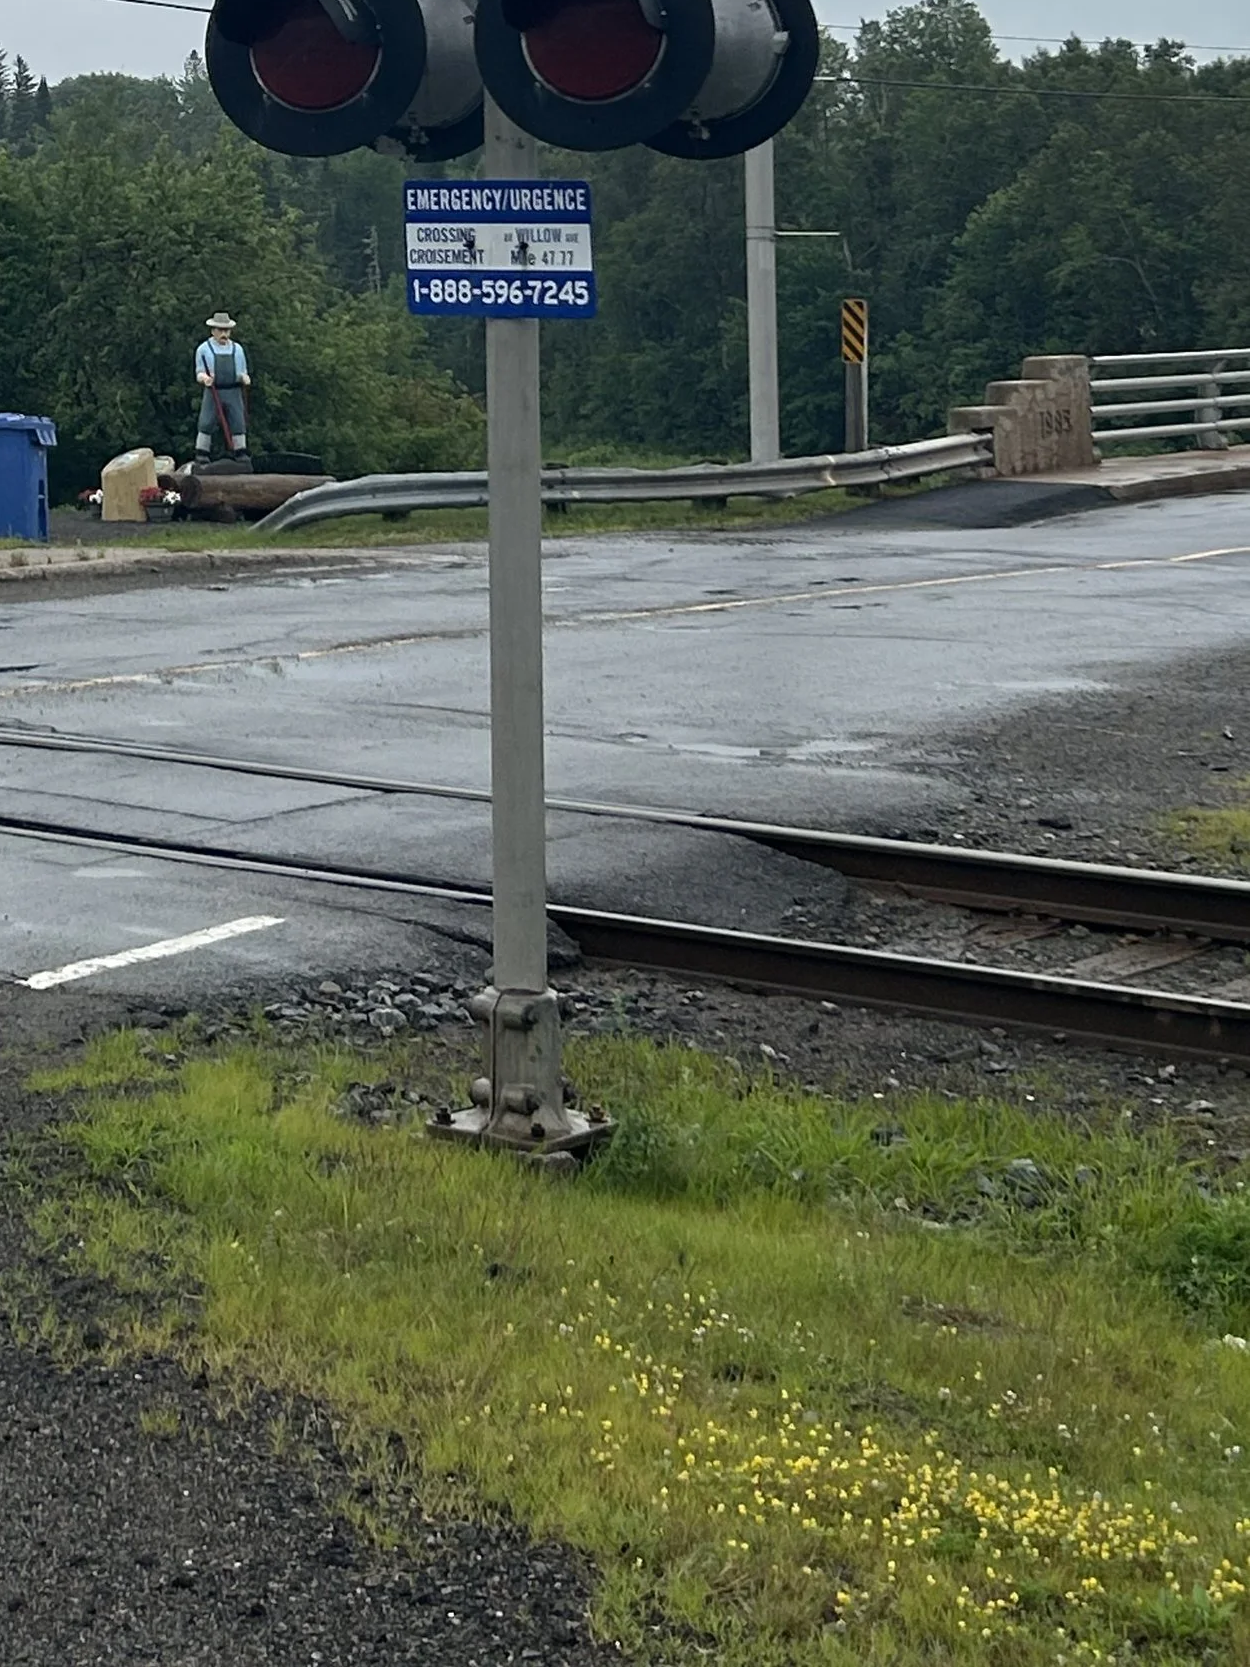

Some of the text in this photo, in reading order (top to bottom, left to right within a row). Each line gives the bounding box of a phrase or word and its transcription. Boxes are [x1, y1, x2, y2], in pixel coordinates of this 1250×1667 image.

[406, 189, 587, 211] EMERGENCY/URGENCE
[417, 227, 476, 243] CROSSING
[515, 228, 562, 243] WILLOW
[410, 248, 484, 265] CROISEMENT
[413, 279, 589, 305] 1-888-596-7245
